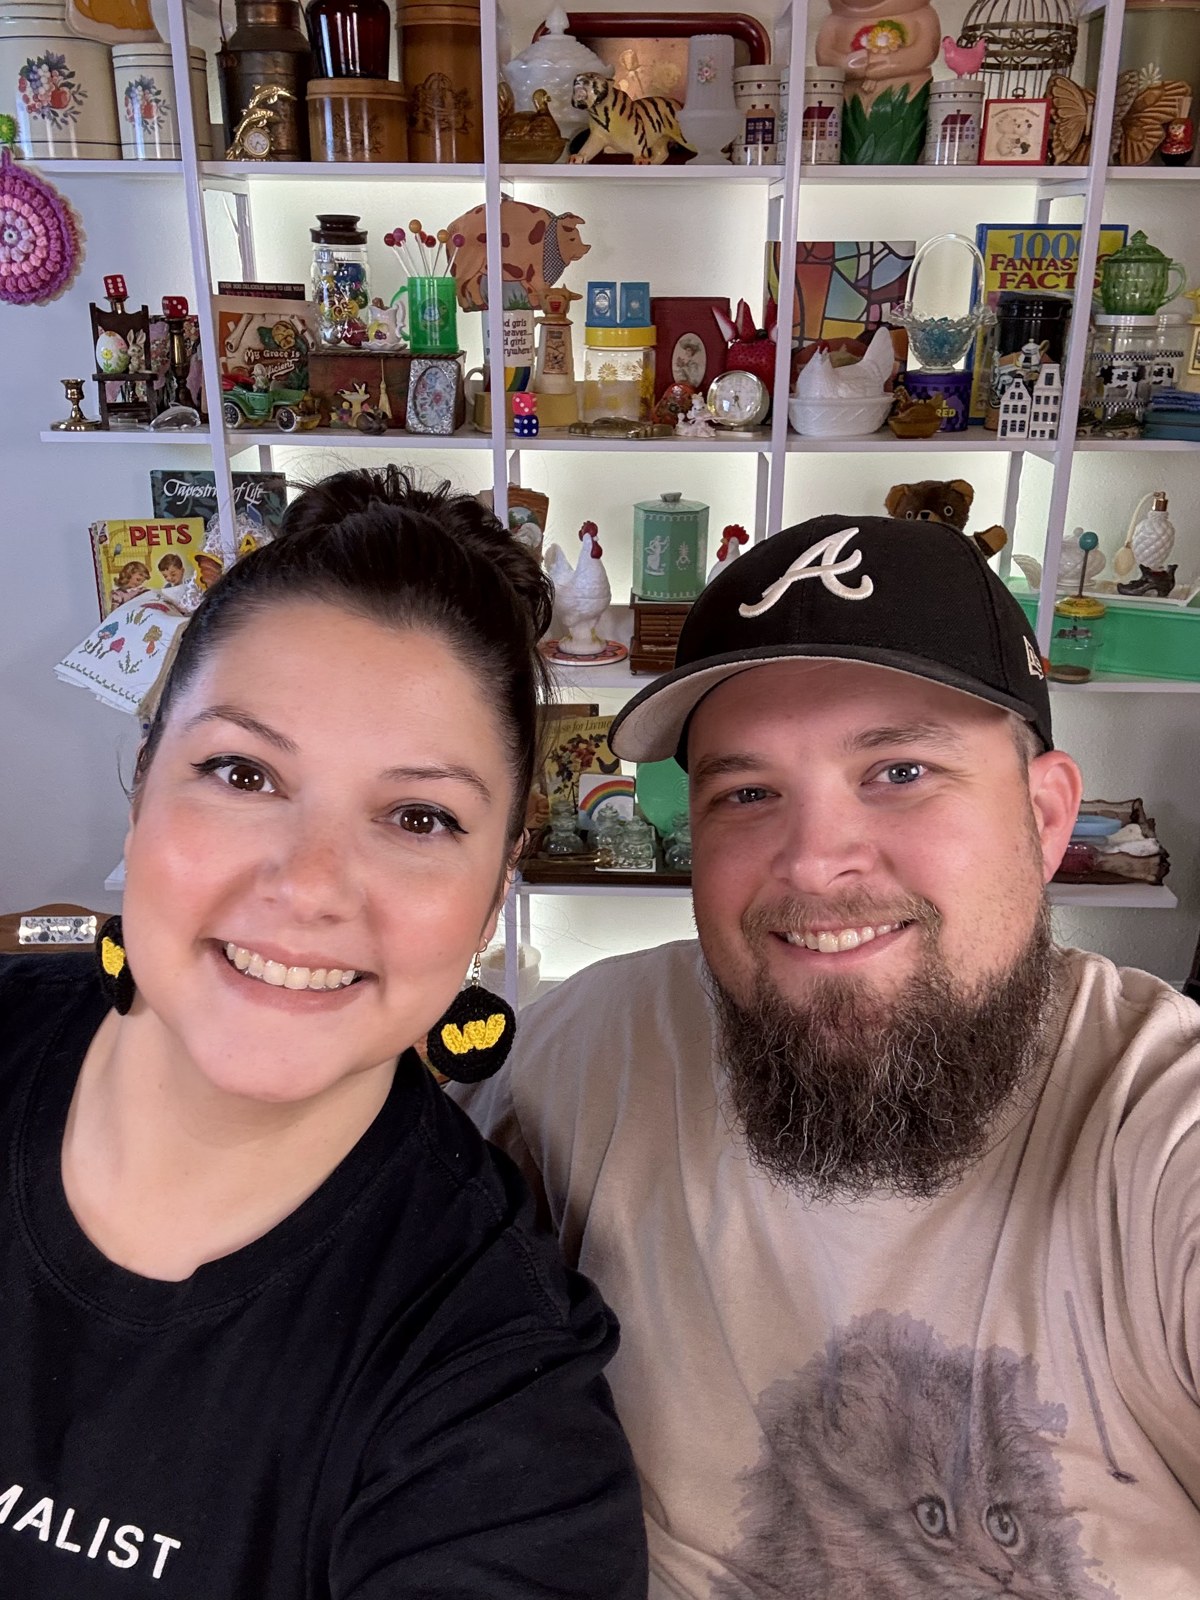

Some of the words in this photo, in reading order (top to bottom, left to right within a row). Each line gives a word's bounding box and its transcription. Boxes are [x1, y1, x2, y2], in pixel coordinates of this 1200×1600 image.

[1008, 232, 1090, 260] 100
[989, 254, 1113, 271] FANTAS
[511, 318, 527, 329] girls
[510, 336, 526, 347] girls
[244, 349, 260, 362] My
[263, 349, 288, 358] Grace
[289, 350, 300, 358] Is
[503, 346, 532, 357] rywhere!
[266, 358, 299, 379] ficient
[163, 478, 218, 505] Tapestr
[232, 481, 247, 504] of
[244, 481, 272, 505] Life
[129, 524, 192, 547] PETS
